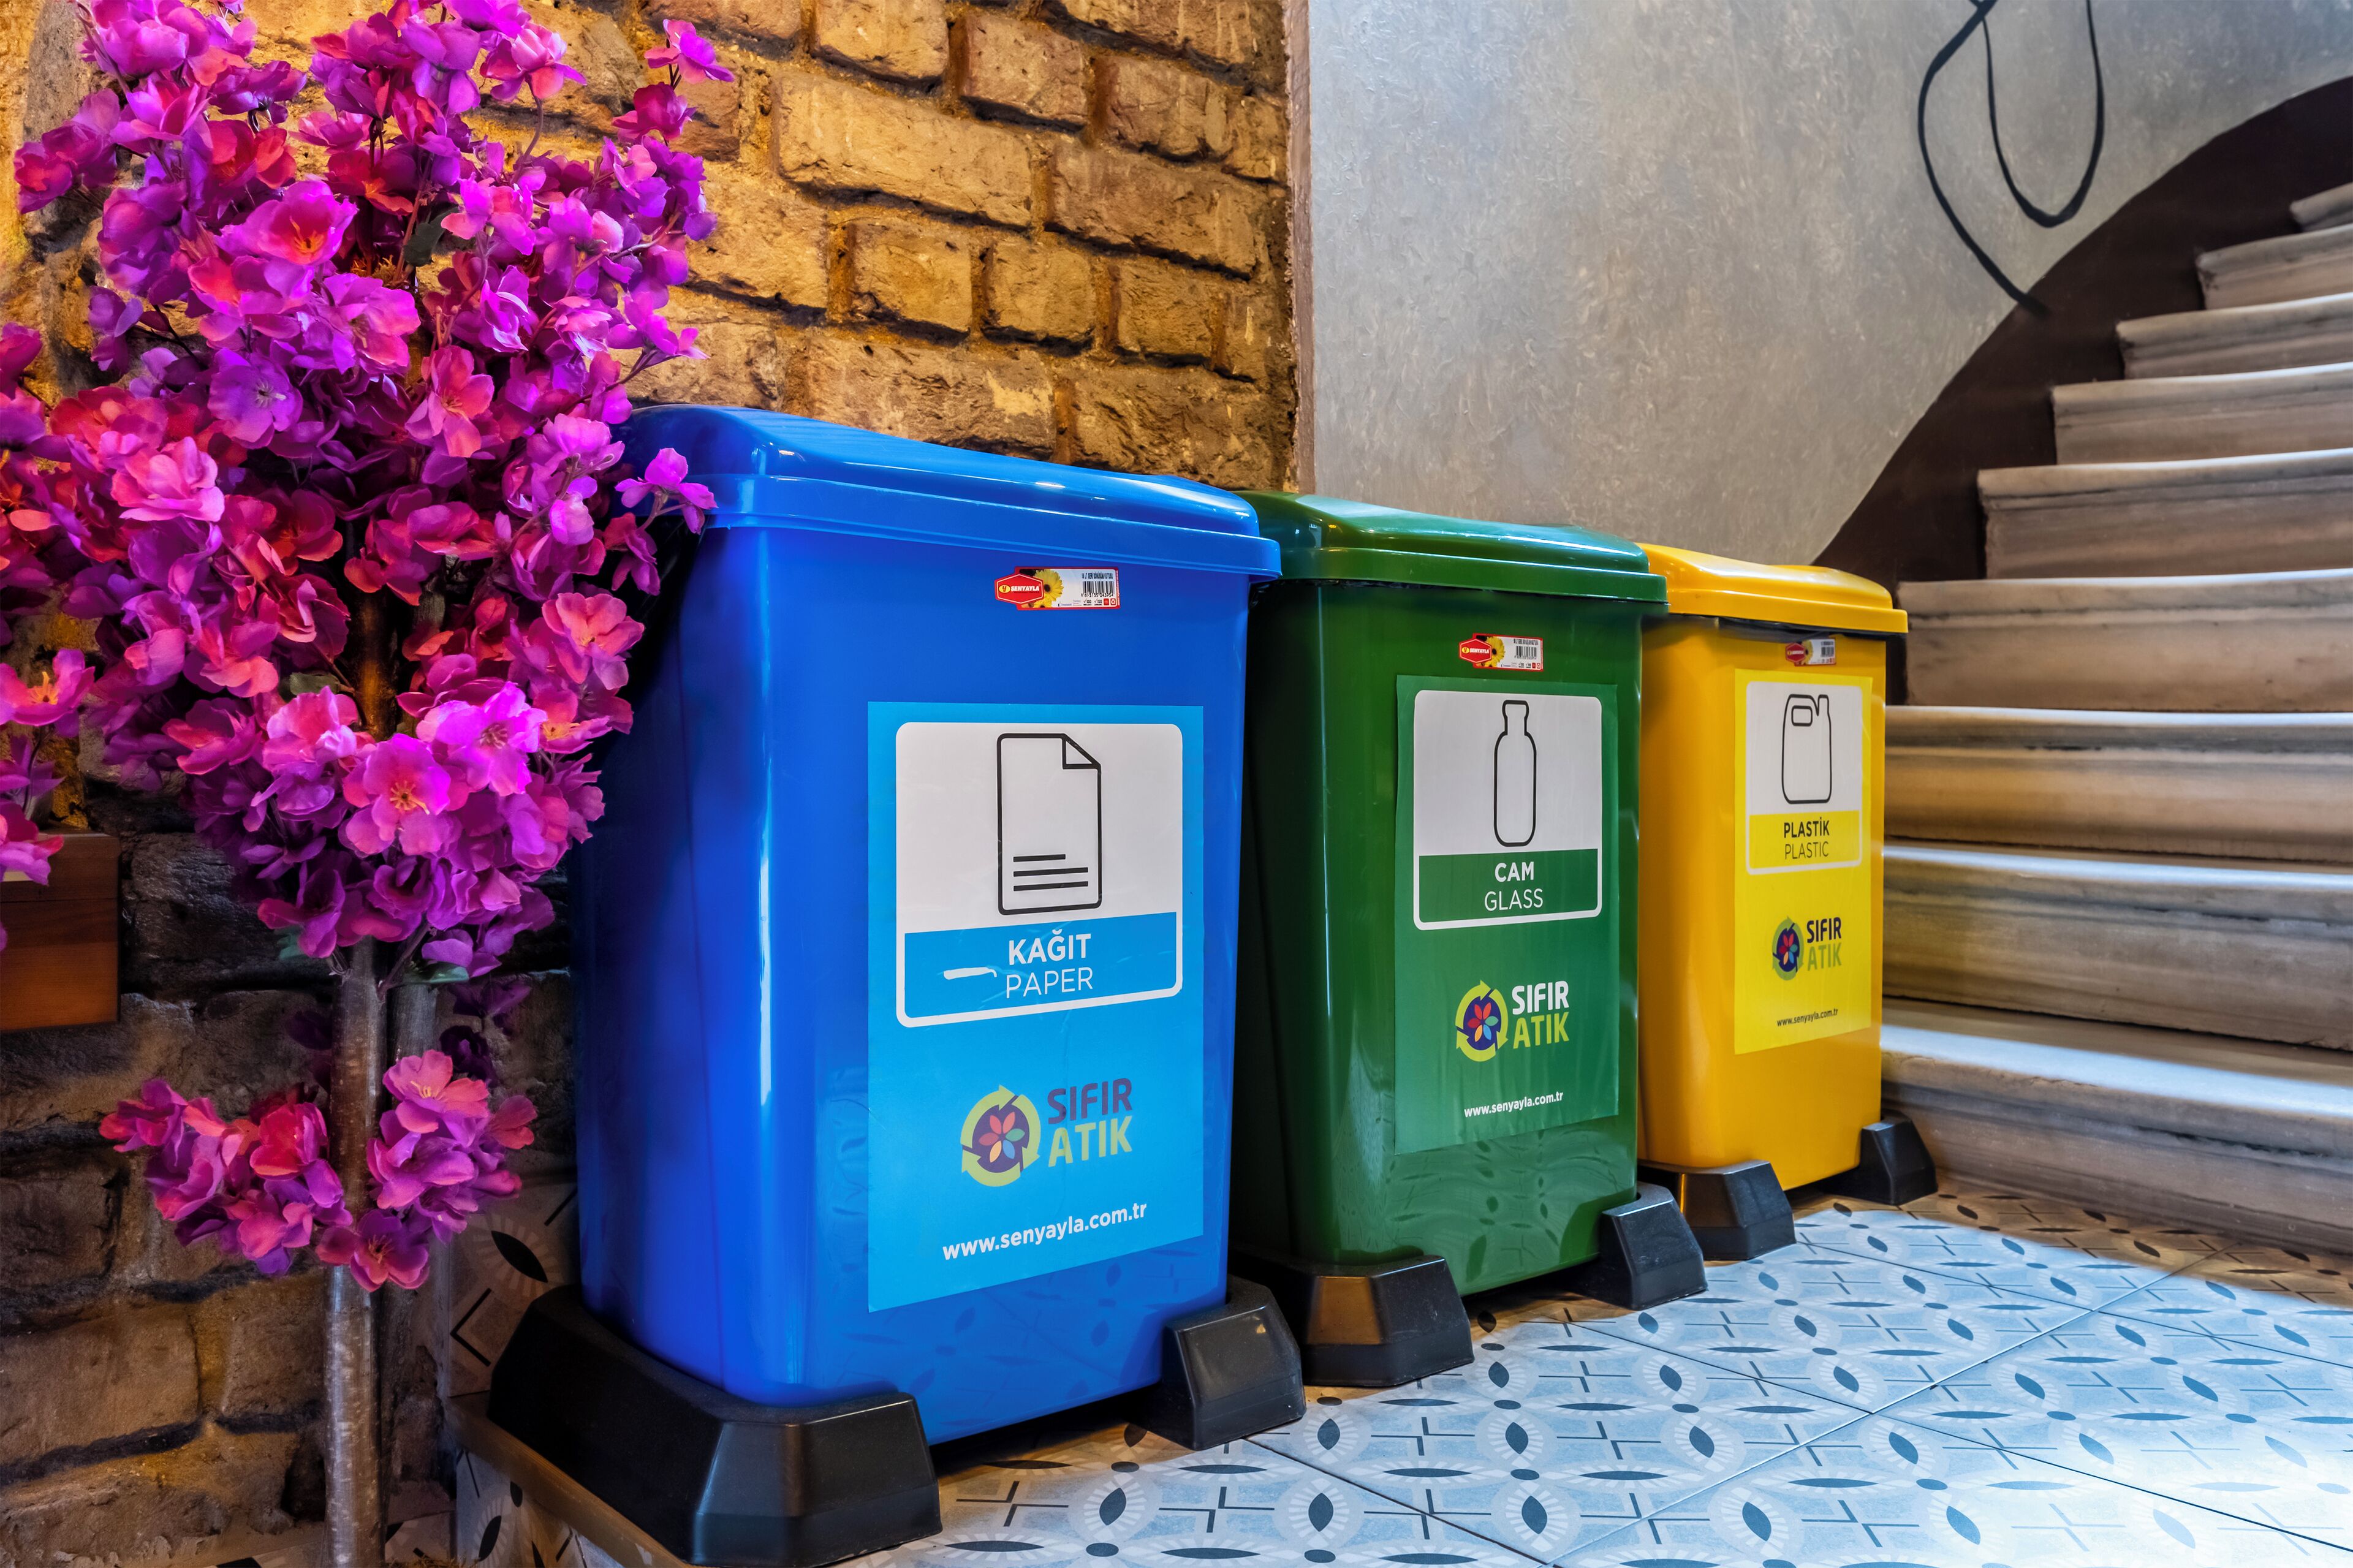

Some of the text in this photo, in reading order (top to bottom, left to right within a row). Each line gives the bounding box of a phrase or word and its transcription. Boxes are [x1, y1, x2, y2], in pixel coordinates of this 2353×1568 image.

[1784, 816, 1830, 838] PLASTİK
[1784, 841, 1829, 860] PLASTIC
[1495, 861, 1534, 883] CAM
[1484, 888, 1544, 912] GLASS
[1806, 917, 1842, 944] SIFIR
[1009, 928, 1092, 966] KAĞIT
[1807, 942, 1842, 971] ATIK
[1006, 967, 1094, 999] PAPER
[1512, 980, 1569, 1015] SIFIR
[1513, 1012, 1569, 1050] ATIK
[1776, 1008, 1839, 1027] www.senyayla.com.tr
[1047, 1078, 1133, 1125] SIFIR
[1463, 1091, 1564, 1118] www.senyayla.com.tr
[1048, 1115, 1133, 1167] ATIK
[942, 1202, 1147, 1261] www.senyayla.com.tr
